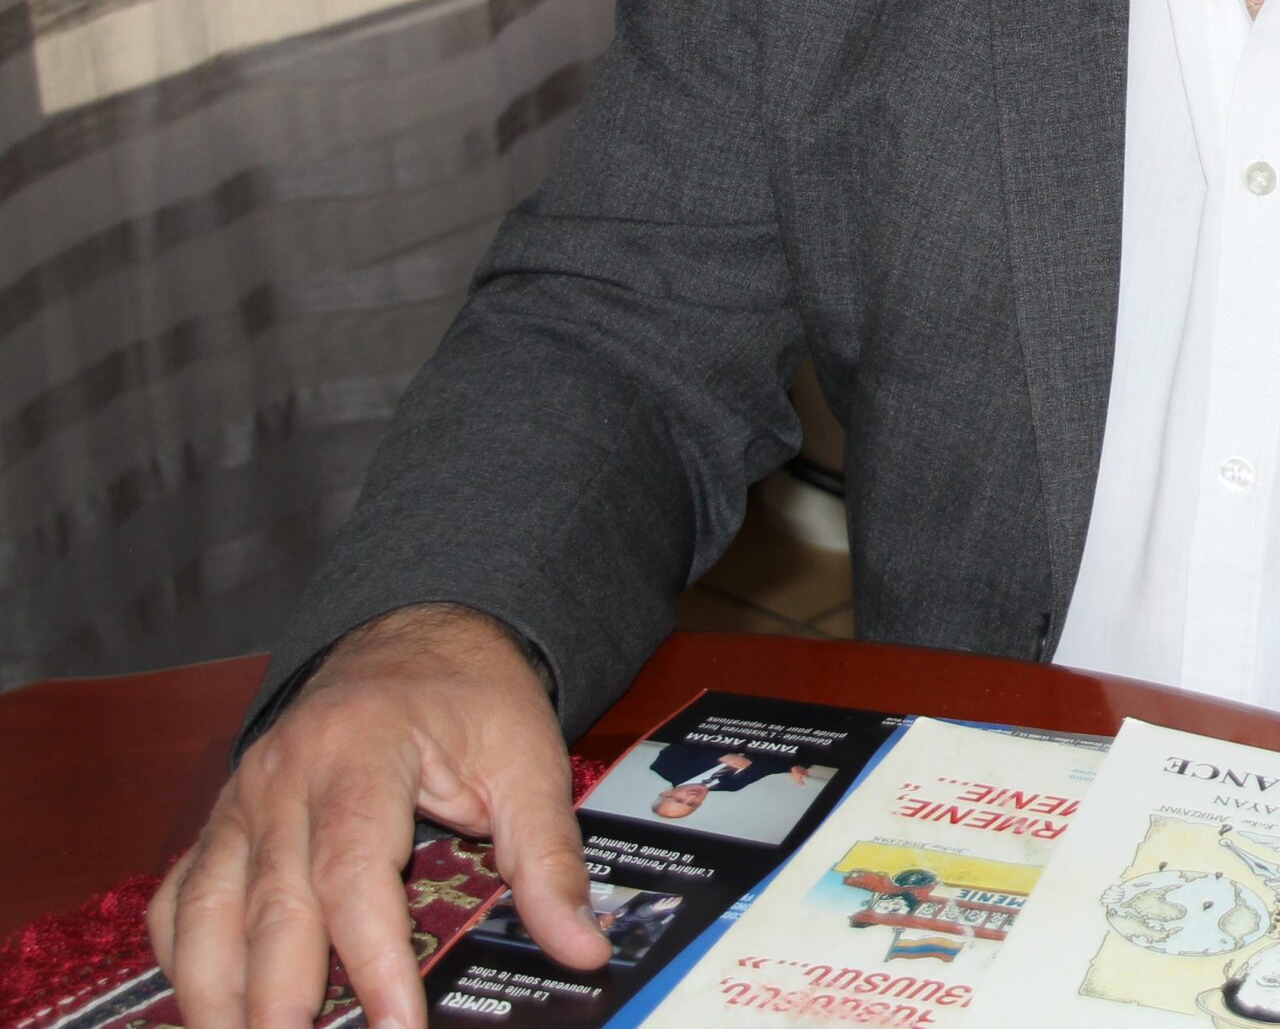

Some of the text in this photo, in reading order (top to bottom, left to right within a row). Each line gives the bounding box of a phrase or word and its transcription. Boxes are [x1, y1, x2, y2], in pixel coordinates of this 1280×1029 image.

[706, 716, 767, 728] réparations
[721, 723, 776, 738] L'historien
[784, 723, 812, 735] pour
[685, 730, 799, 754] TANER AKÇAM
[813, 727, 848, 740] plaide
[1154, 804, 1231, 825] AMIRZAYAN
[588, 835, 694, 864] la Grande Chambre
[618, 853, 668, 871] Perincek
[668, 863, 715, 878] L'affaire
[458, 976, 550, 1001] La ville martyre
[468, 965, 602, 998] à nouveau sous le choc
[440, 991, 512, 1015] GUMRI
